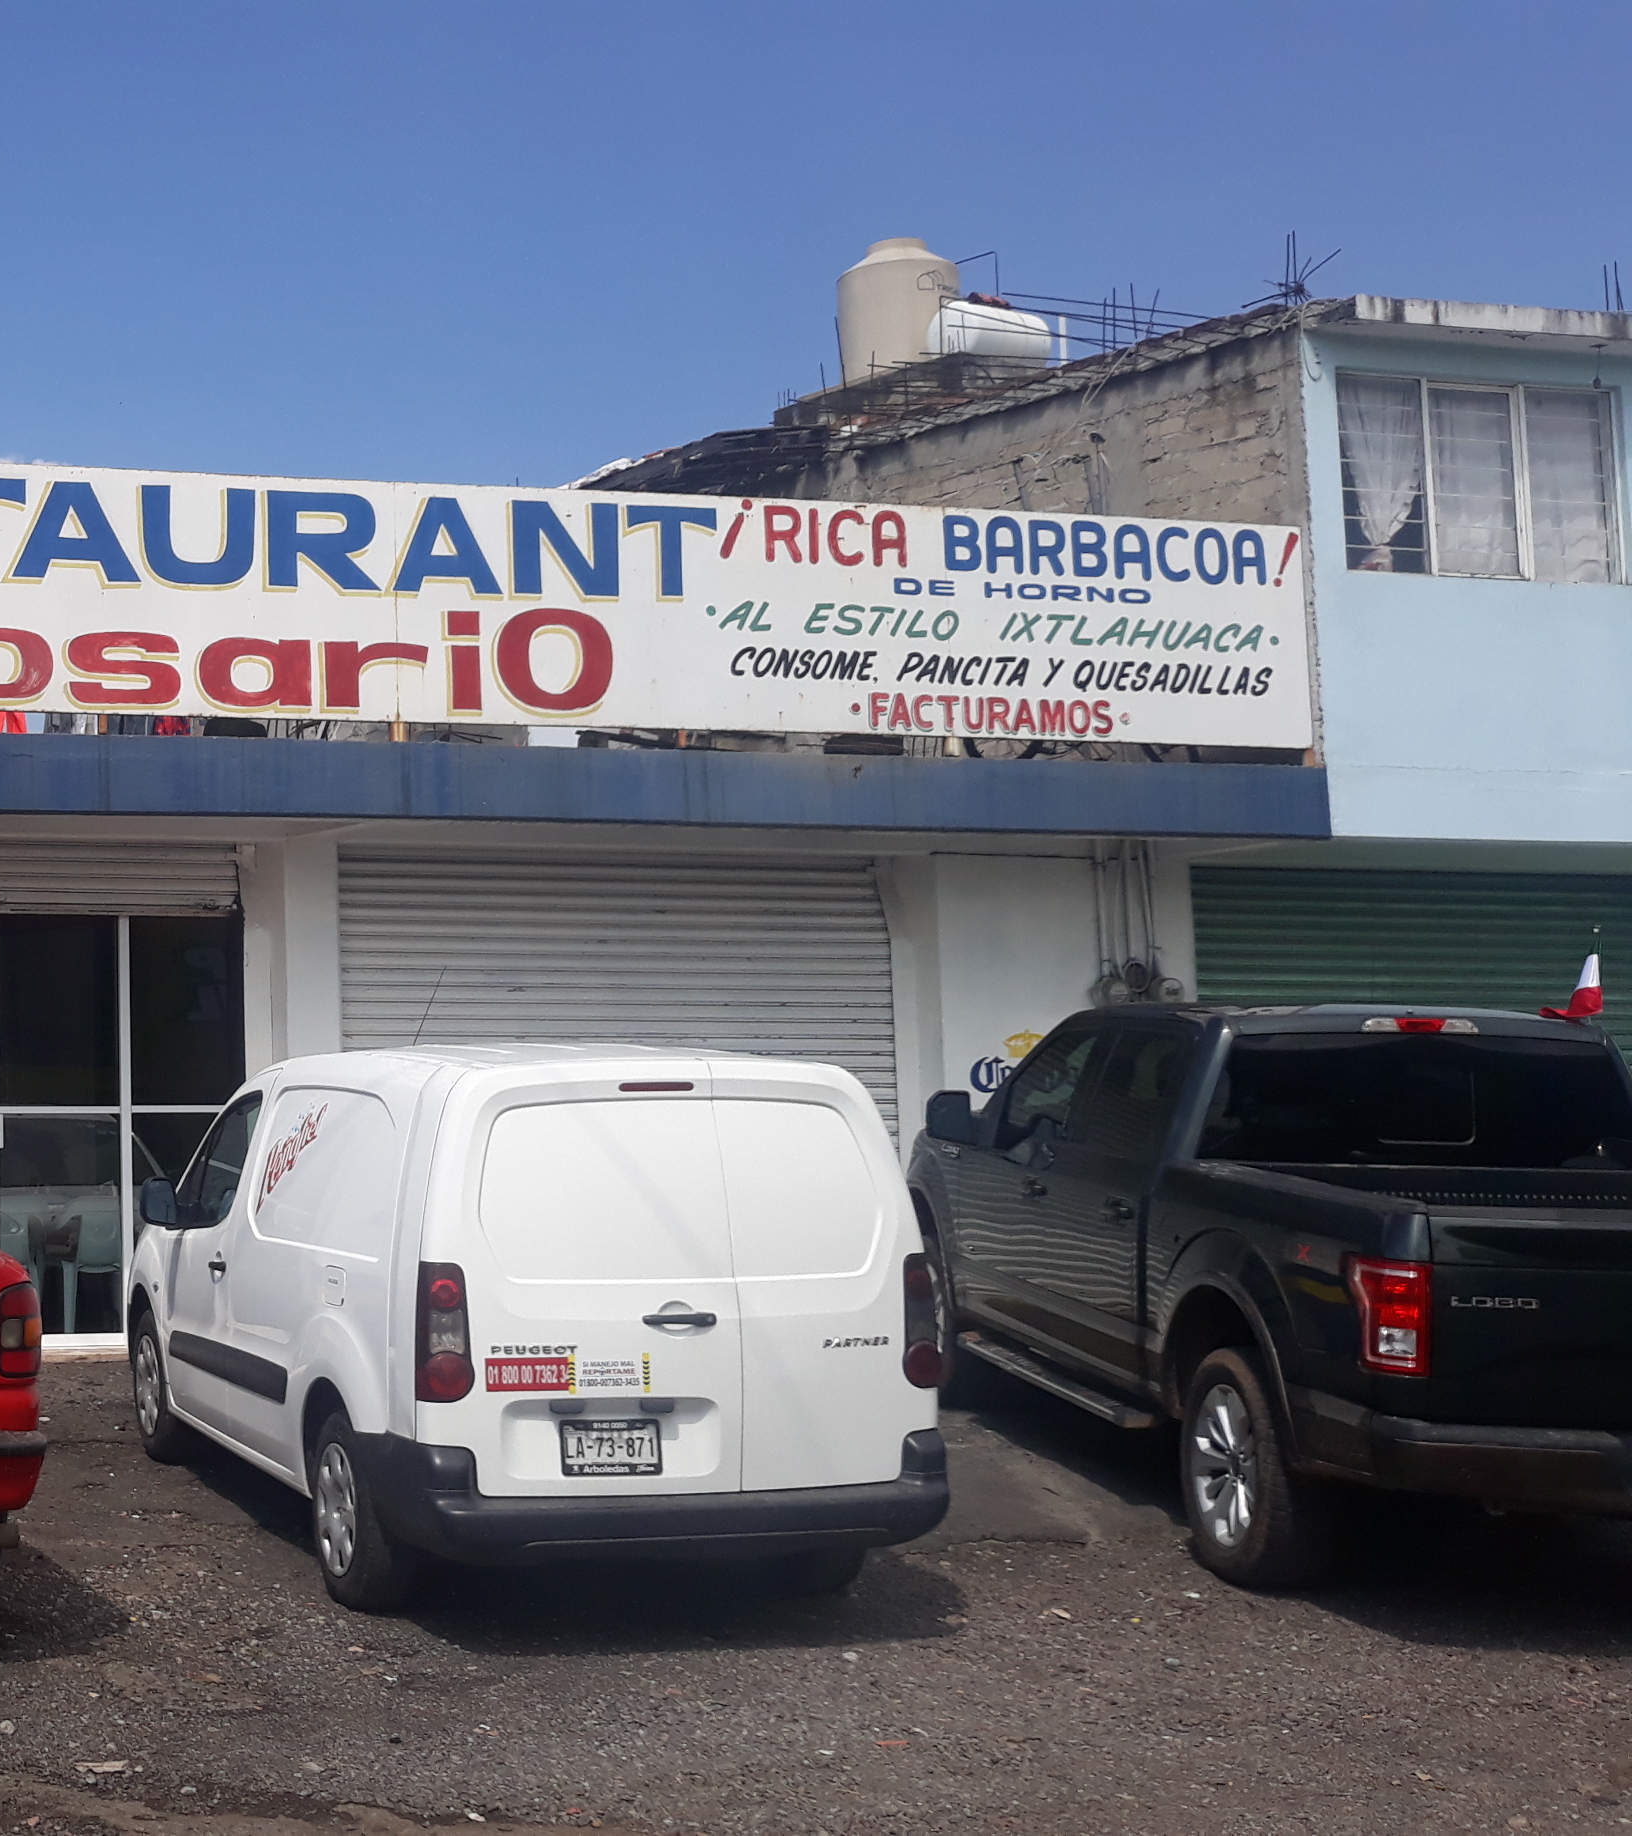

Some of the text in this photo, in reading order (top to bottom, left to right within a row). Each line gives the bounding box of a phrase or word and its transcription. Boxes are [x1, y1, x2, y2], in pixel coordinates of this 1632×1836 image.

[894, 577, 1151, 604] DE HORNO
[803, 603, 960, 641] ESTILO
[896, 652, 1031, 688] PANCITA
[1041, 656, 1065, 686] Y
[1072, 660, 1272, 697] QUESADILLAS
[1450, 1295, 1539, 1309] LOBO
[491, 1345, 578, 1355] PEUGEOT
[822, 1336, 890, 1349] PARTNER
[487, 1365, 498, 1384] 01
[501, 1365, 519, 1384] 800
[521, 1365, 533, 1384] 00
[534, 1365, 558, 1384] 7362
[565, 1436, 655, 1459] LA-73-871
[583, 1464, 630, 1473] Arboledas
